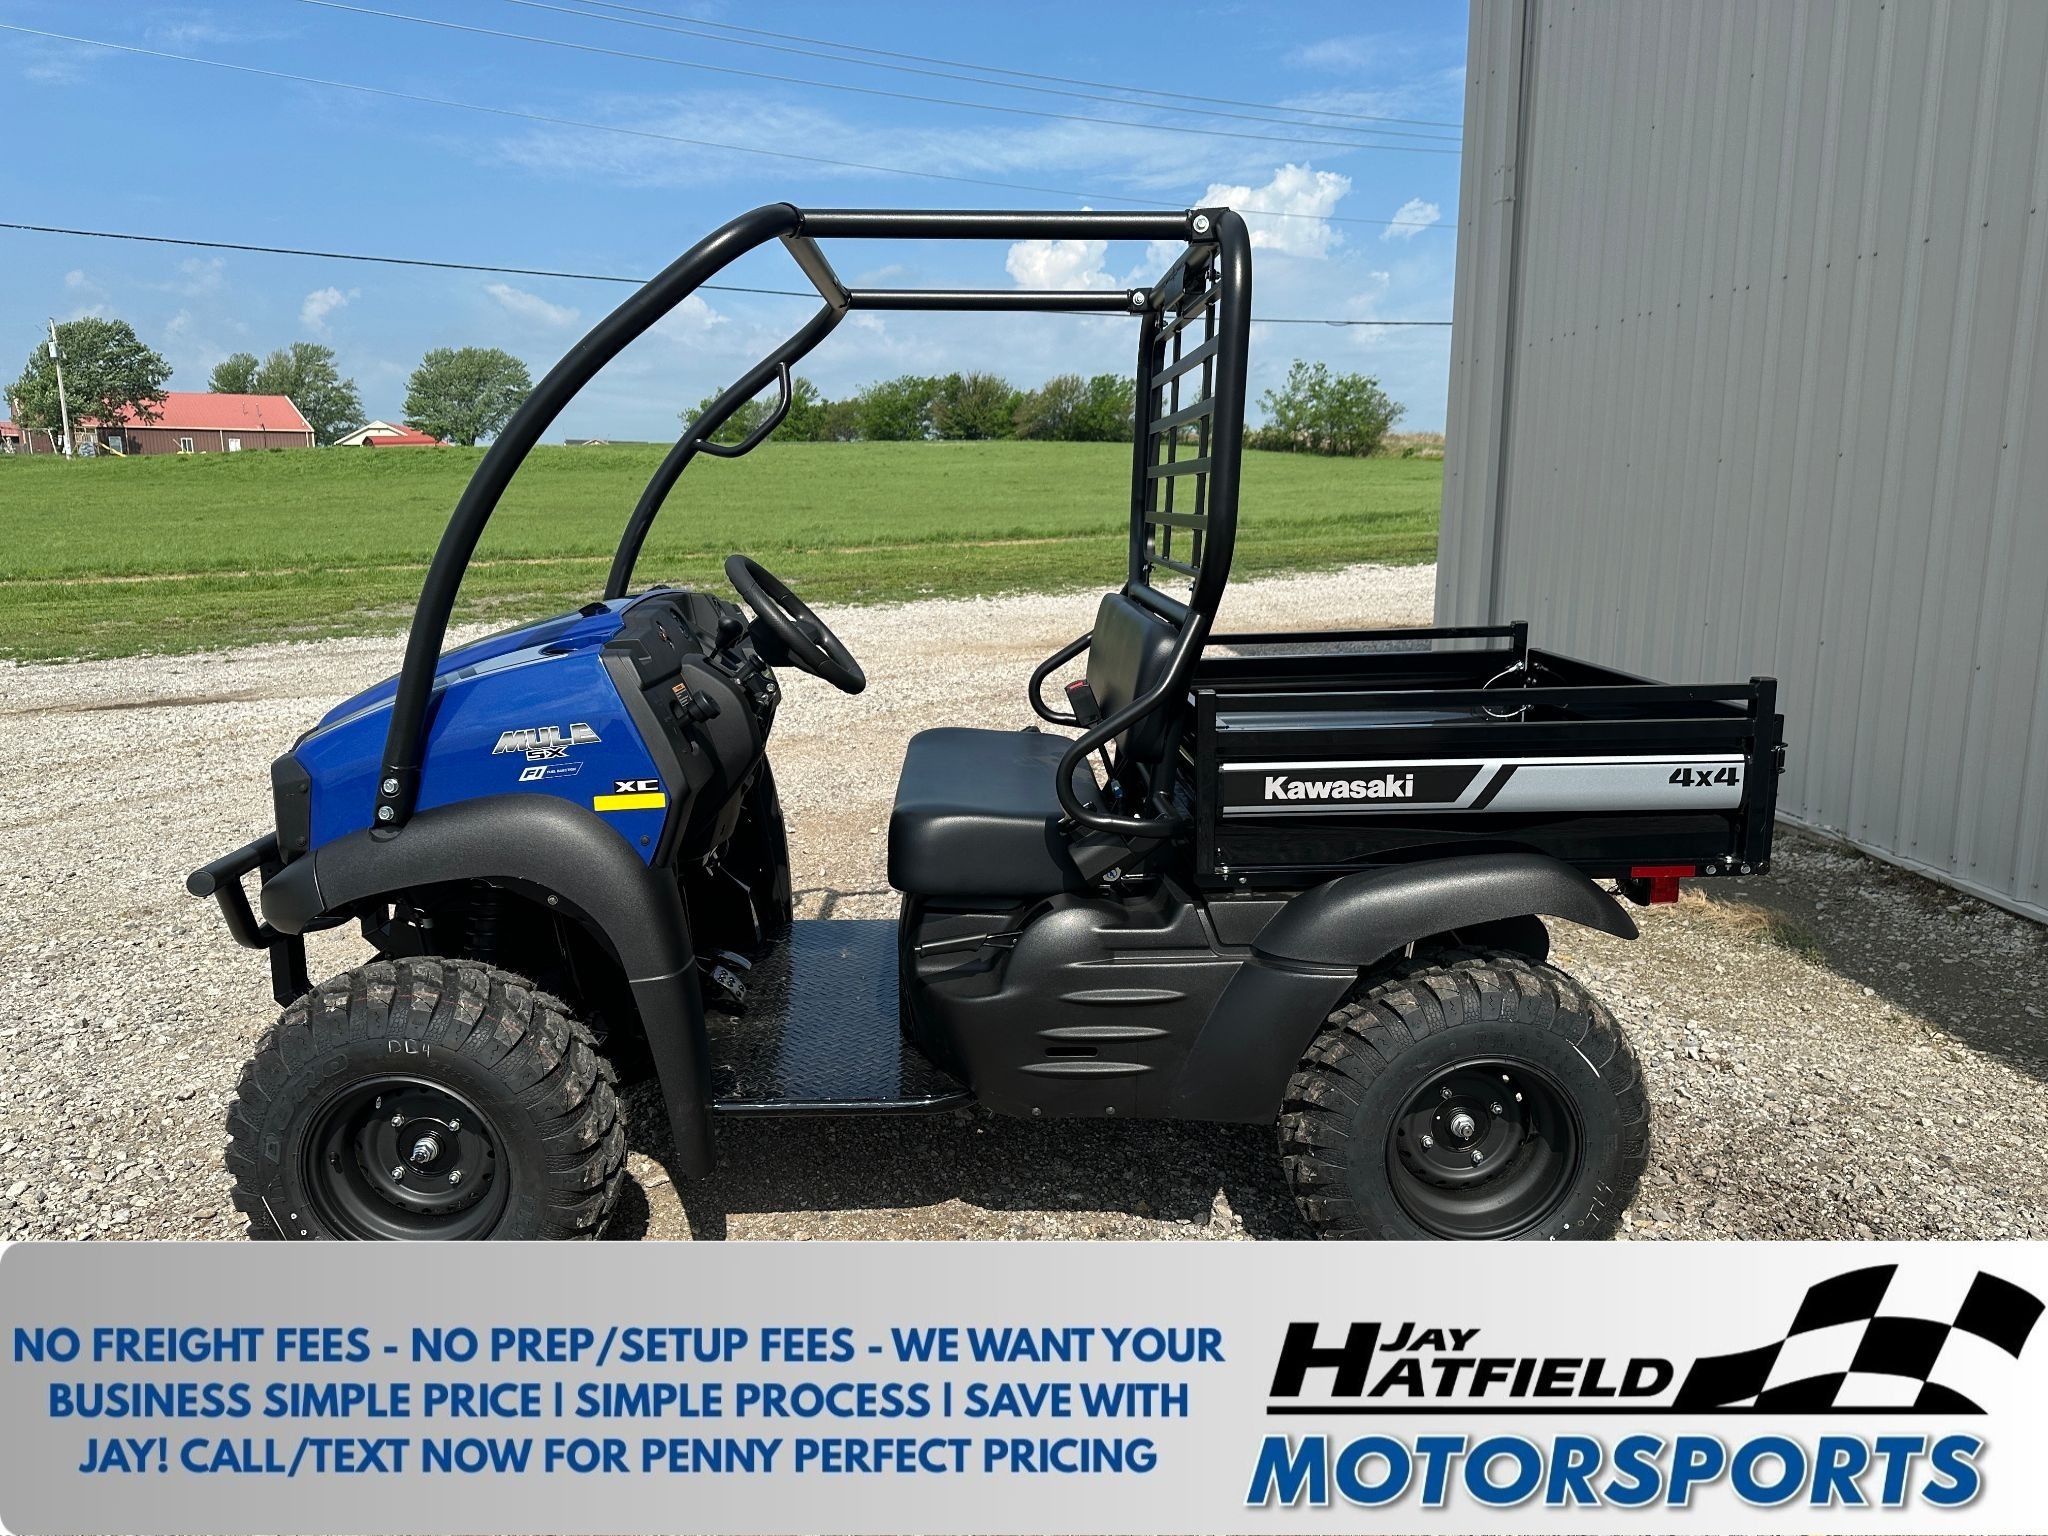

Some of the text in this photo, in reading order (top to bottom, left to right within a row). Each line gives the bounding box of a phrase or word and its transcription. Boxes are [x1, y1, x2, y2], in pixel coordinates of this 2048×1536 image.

[492, 722, 601, 755] MULE
[526, 745, 569, 762] SX
[615, 779, 659, 793] XC
[1264, 773, 1414, 800] Kawasaki
[1668, 767, 1740, 787] 4x4
